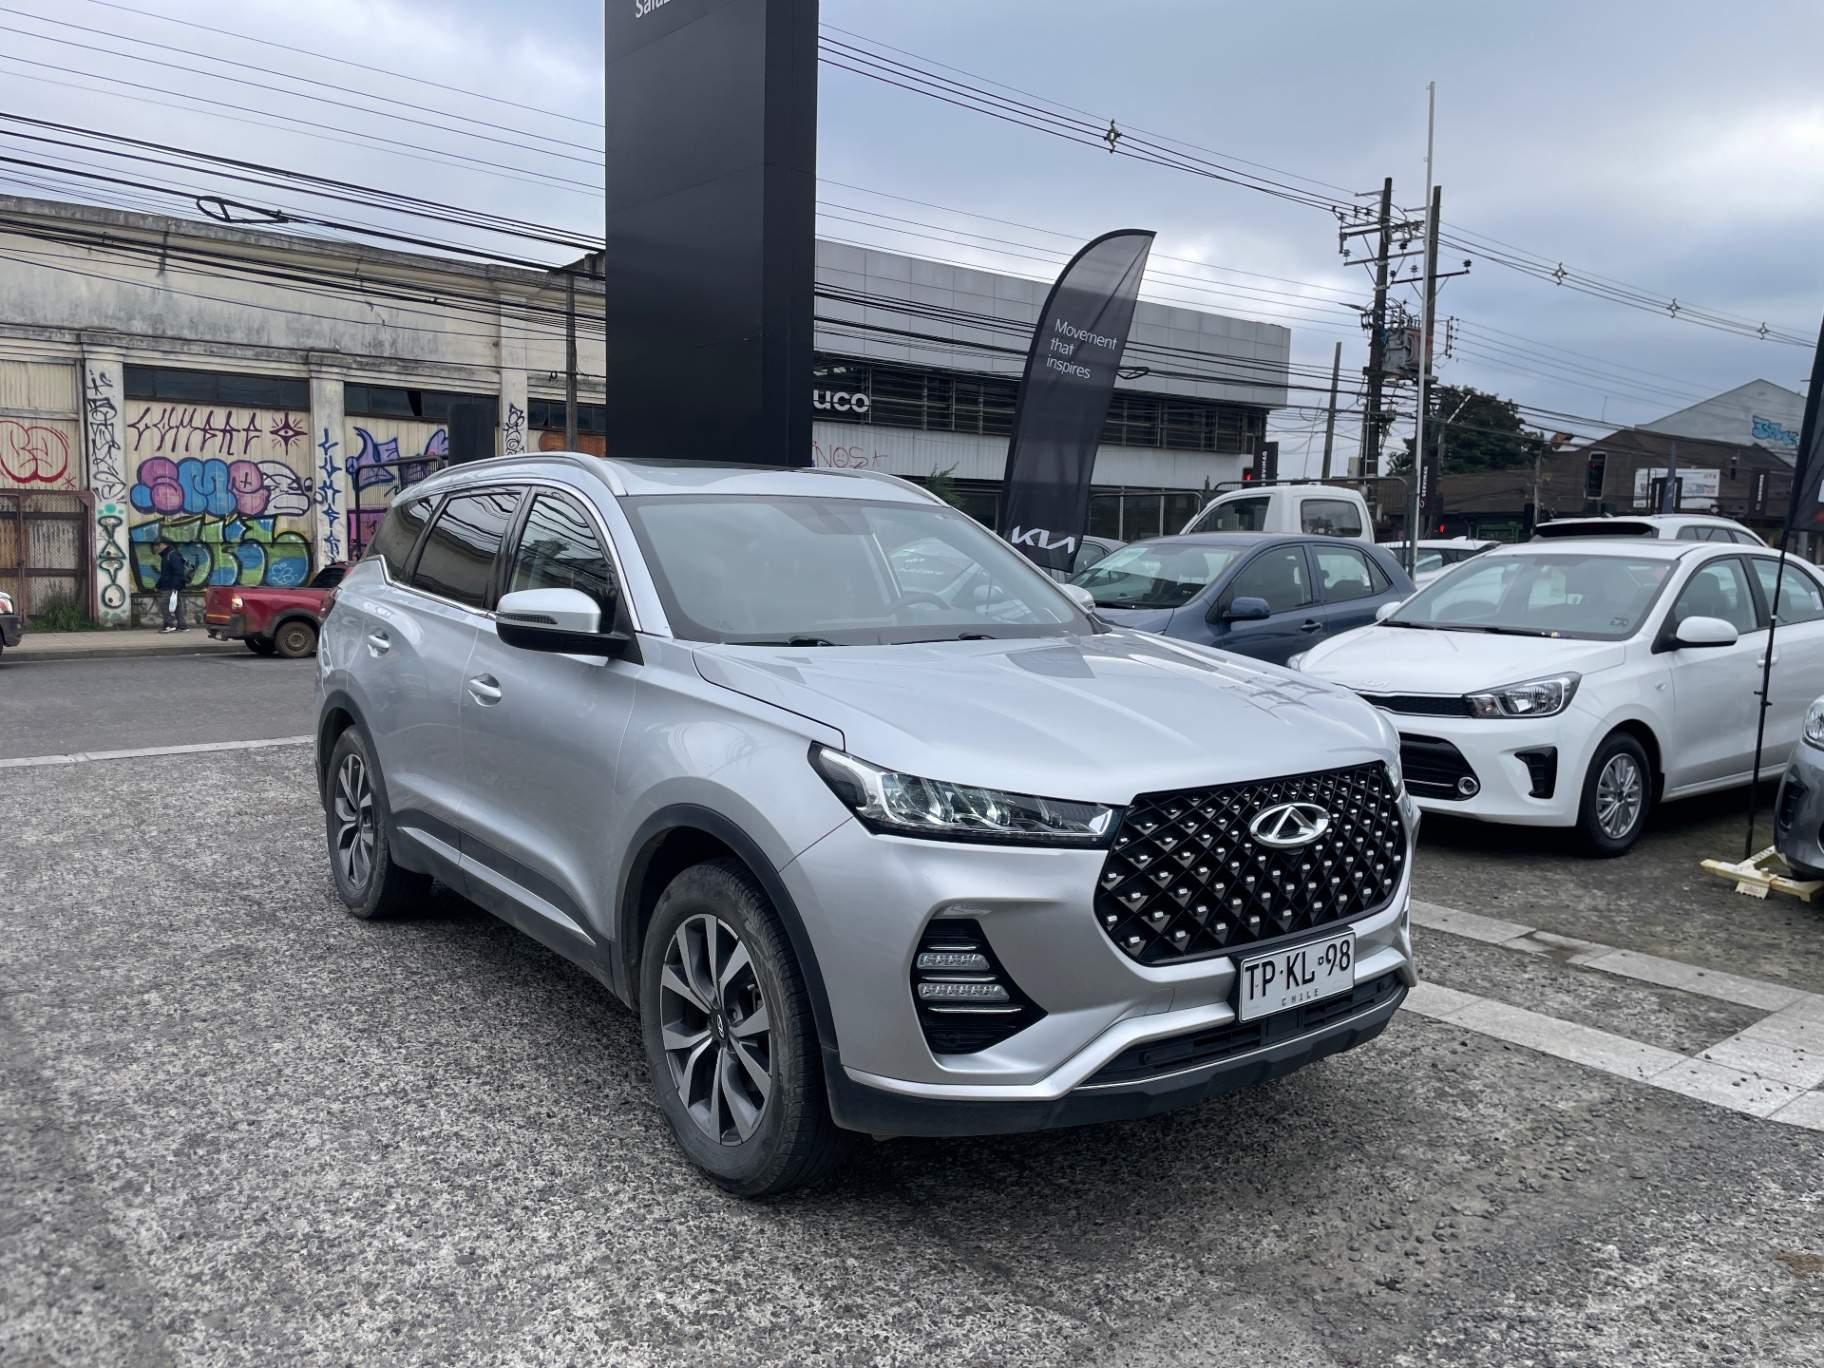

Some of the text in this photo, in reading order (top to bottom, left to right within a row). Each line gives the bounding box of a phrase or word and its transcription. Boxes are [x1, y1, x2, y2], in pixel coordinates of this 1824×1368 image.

[1050, 338, 1074, 355] that
[1055, 318, 1117, 350] Movement
[1047, 354, 1091, 379] inspires
[1011, 525, 1075, 554] KIA
[1281, 987, 1320, 1007] CHILE
